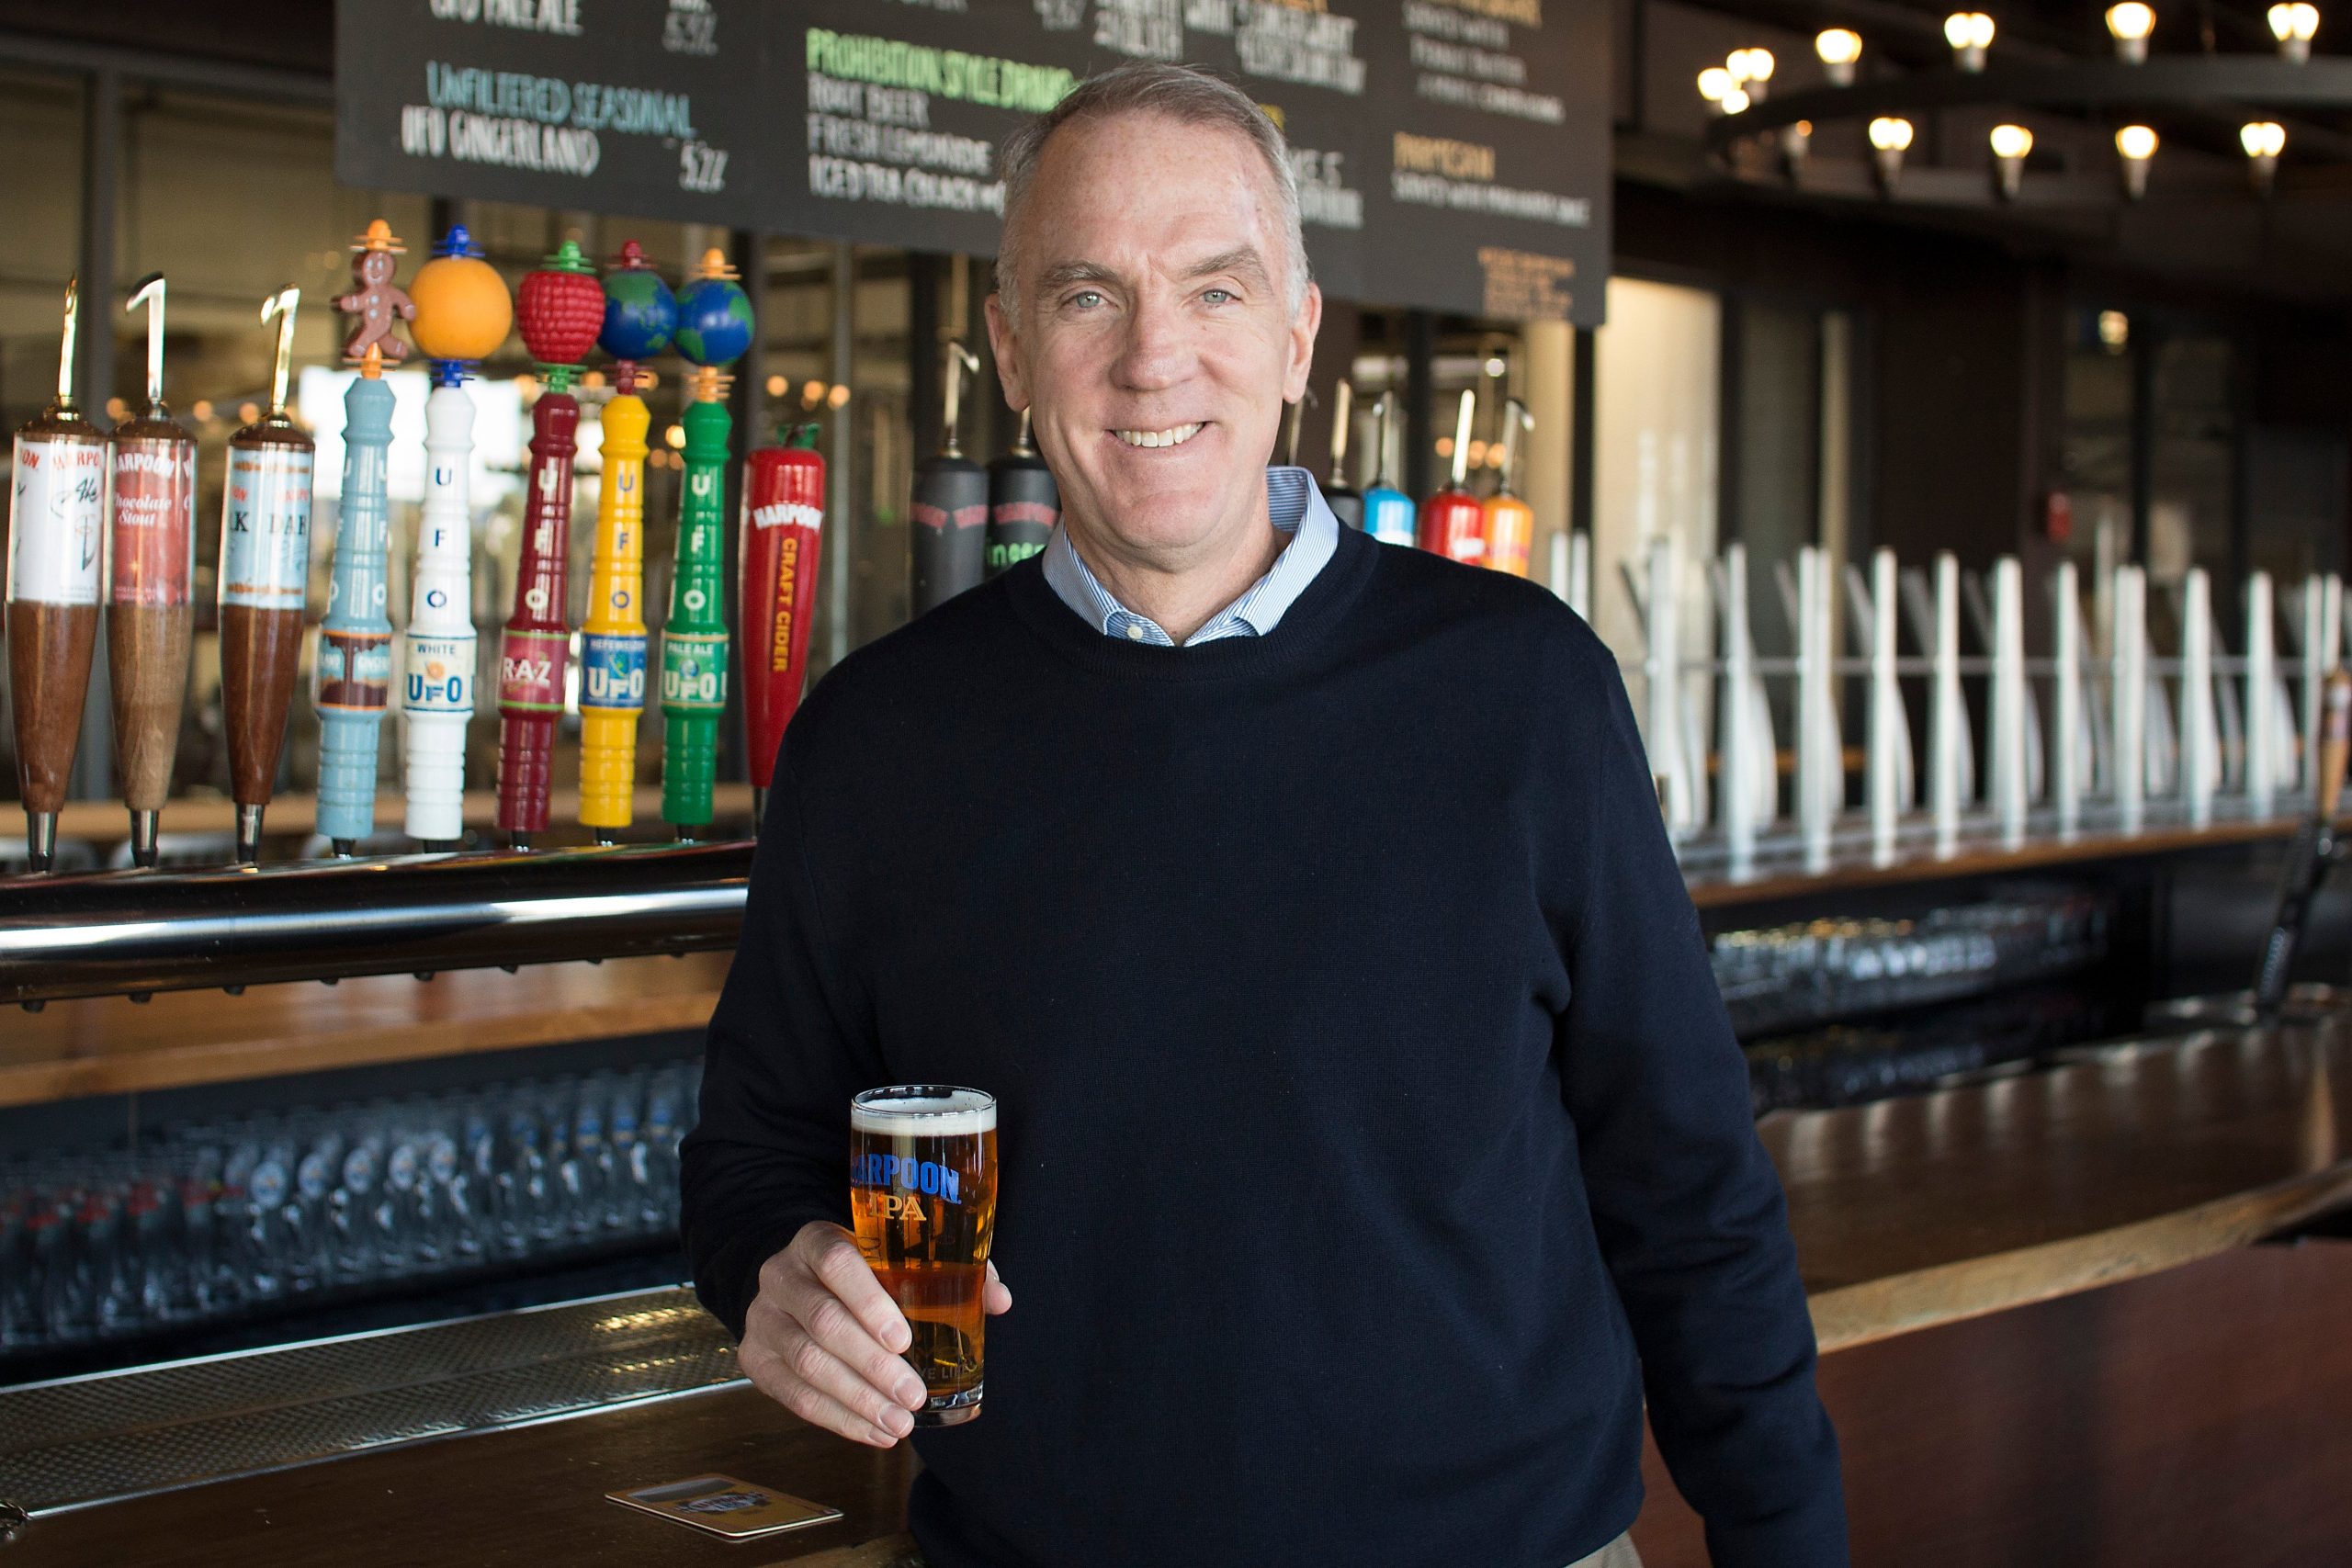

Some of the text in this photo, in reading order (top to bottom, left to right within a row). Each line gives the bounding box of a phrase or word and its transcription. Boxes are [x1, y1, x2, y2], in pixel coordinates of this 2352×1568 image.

[425, 60, 697, 139] UNFILTERED SEASONAL
[114, 453, 175, 479] ARPOON
[116, 493, 173, 512] hocolate
[773, 537, 797, 671] CRAFT CIDER
[417, 644, 456, 655] WHITE
[408, 672, 463, 704] UFO
[503, 656, 552, 689] RAZ
[588, 667, 644, 699] UFO
[664, 671, 718, 700] UFO
[869, 1191, 927, 1221] IPA
